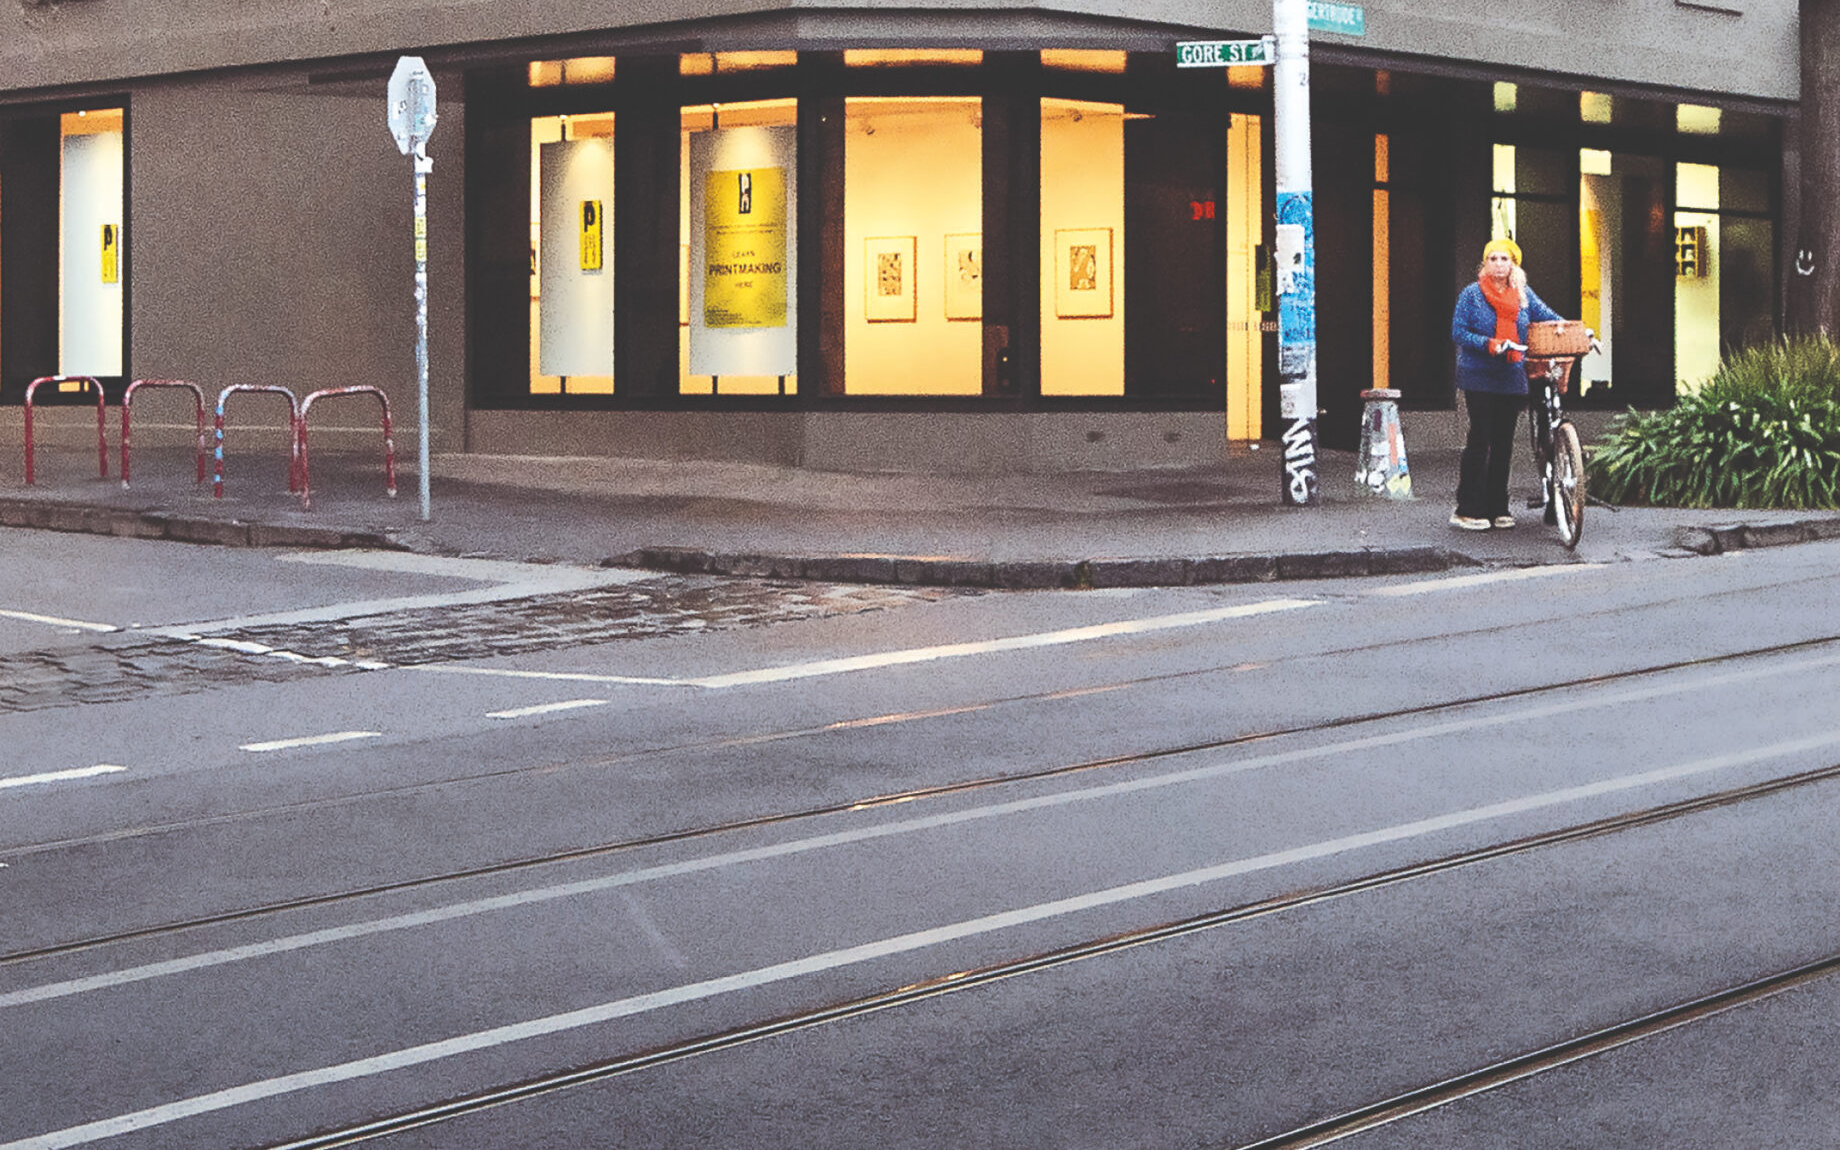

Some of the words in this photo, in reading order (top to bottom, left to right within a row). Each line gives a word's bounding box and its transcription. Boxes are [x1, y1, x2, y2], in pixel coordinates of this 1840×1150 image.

[1182, 45, 1224, 63] GORE
[1229, 43, 1247, 61] ST
[709, 262, 781, 276] PRINTMAKING
